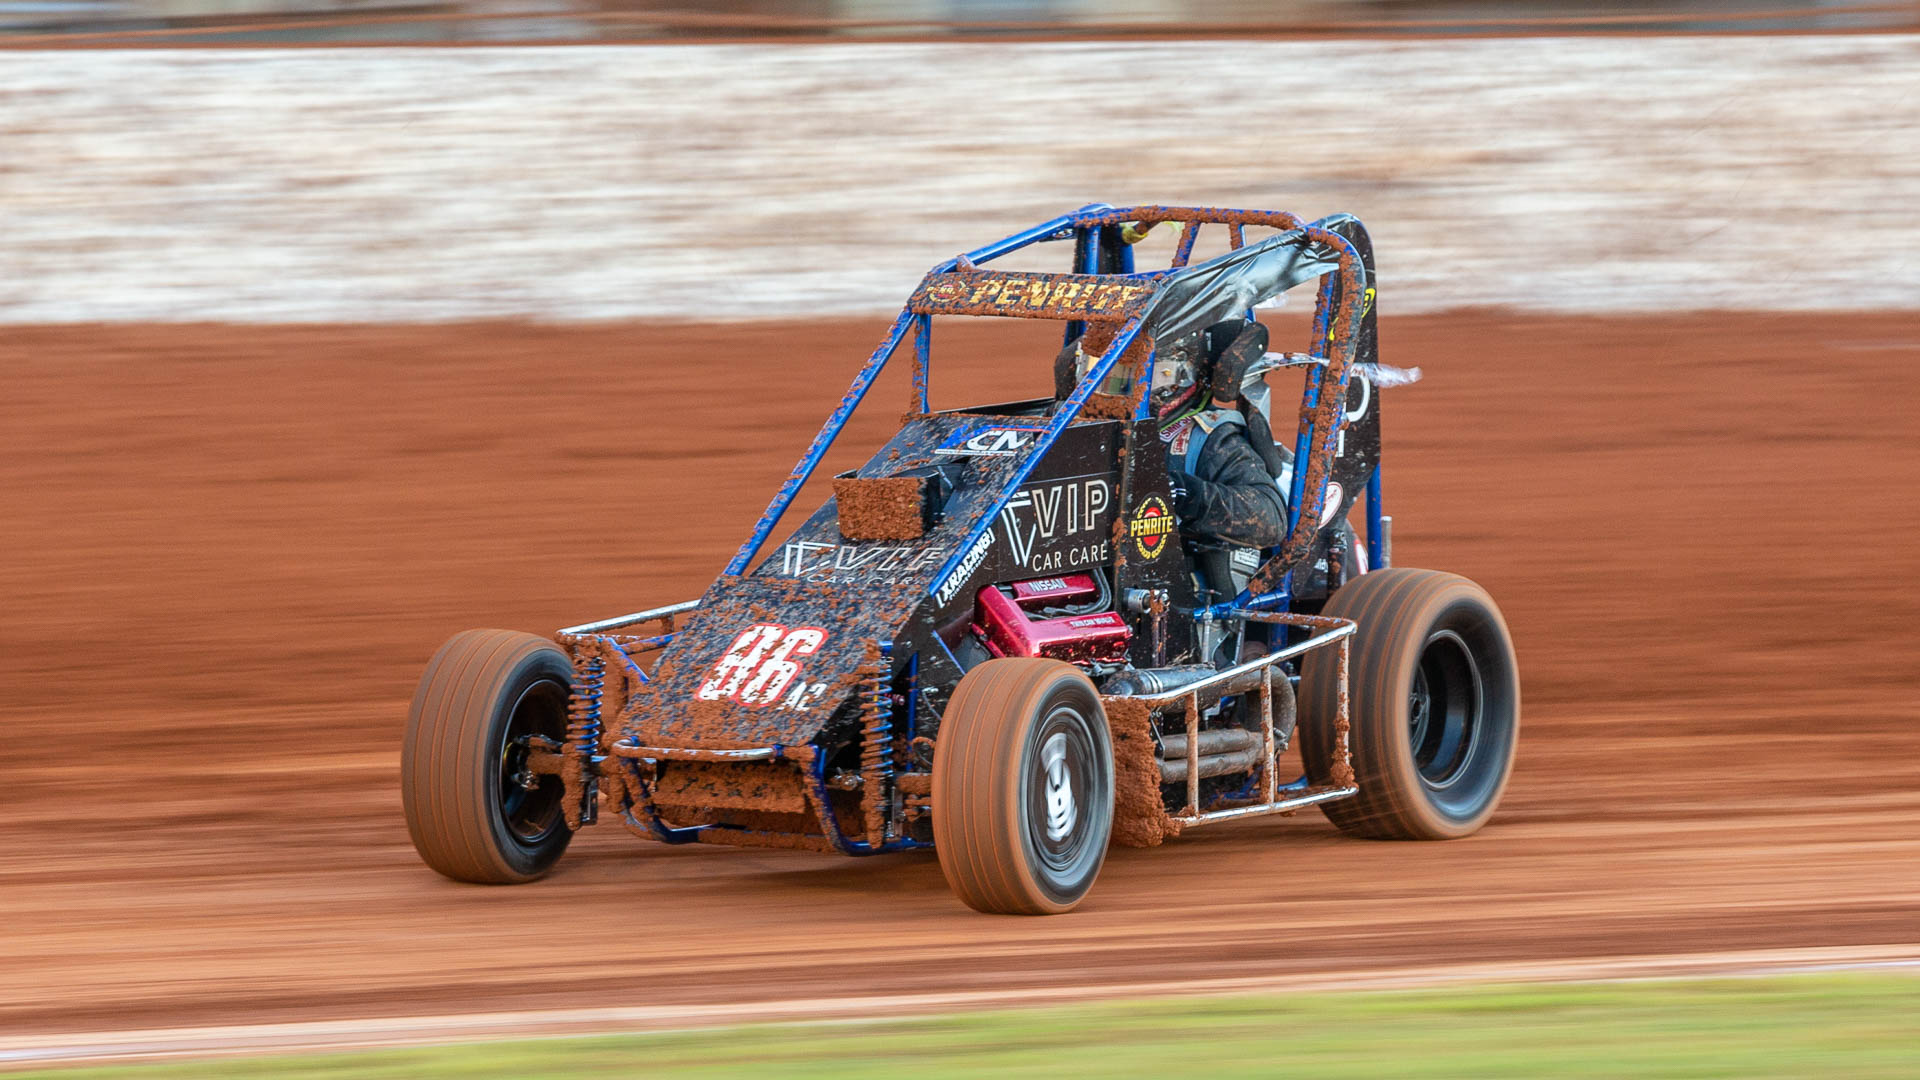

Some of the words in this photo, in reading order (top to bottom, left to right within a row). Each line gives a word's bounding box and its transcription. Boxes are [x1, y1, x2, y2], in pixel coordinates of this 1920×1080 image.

[1032, 479, 1109, 538] VIP
[1130, 515, 1173, 537] PENRITE
[1032, 551, 1062, 572] CAR
[1069, 543, 1108, 566] CARE
[1028, 578, 1068, 592] NISSAN
[695, 623, 828, 706] 86
